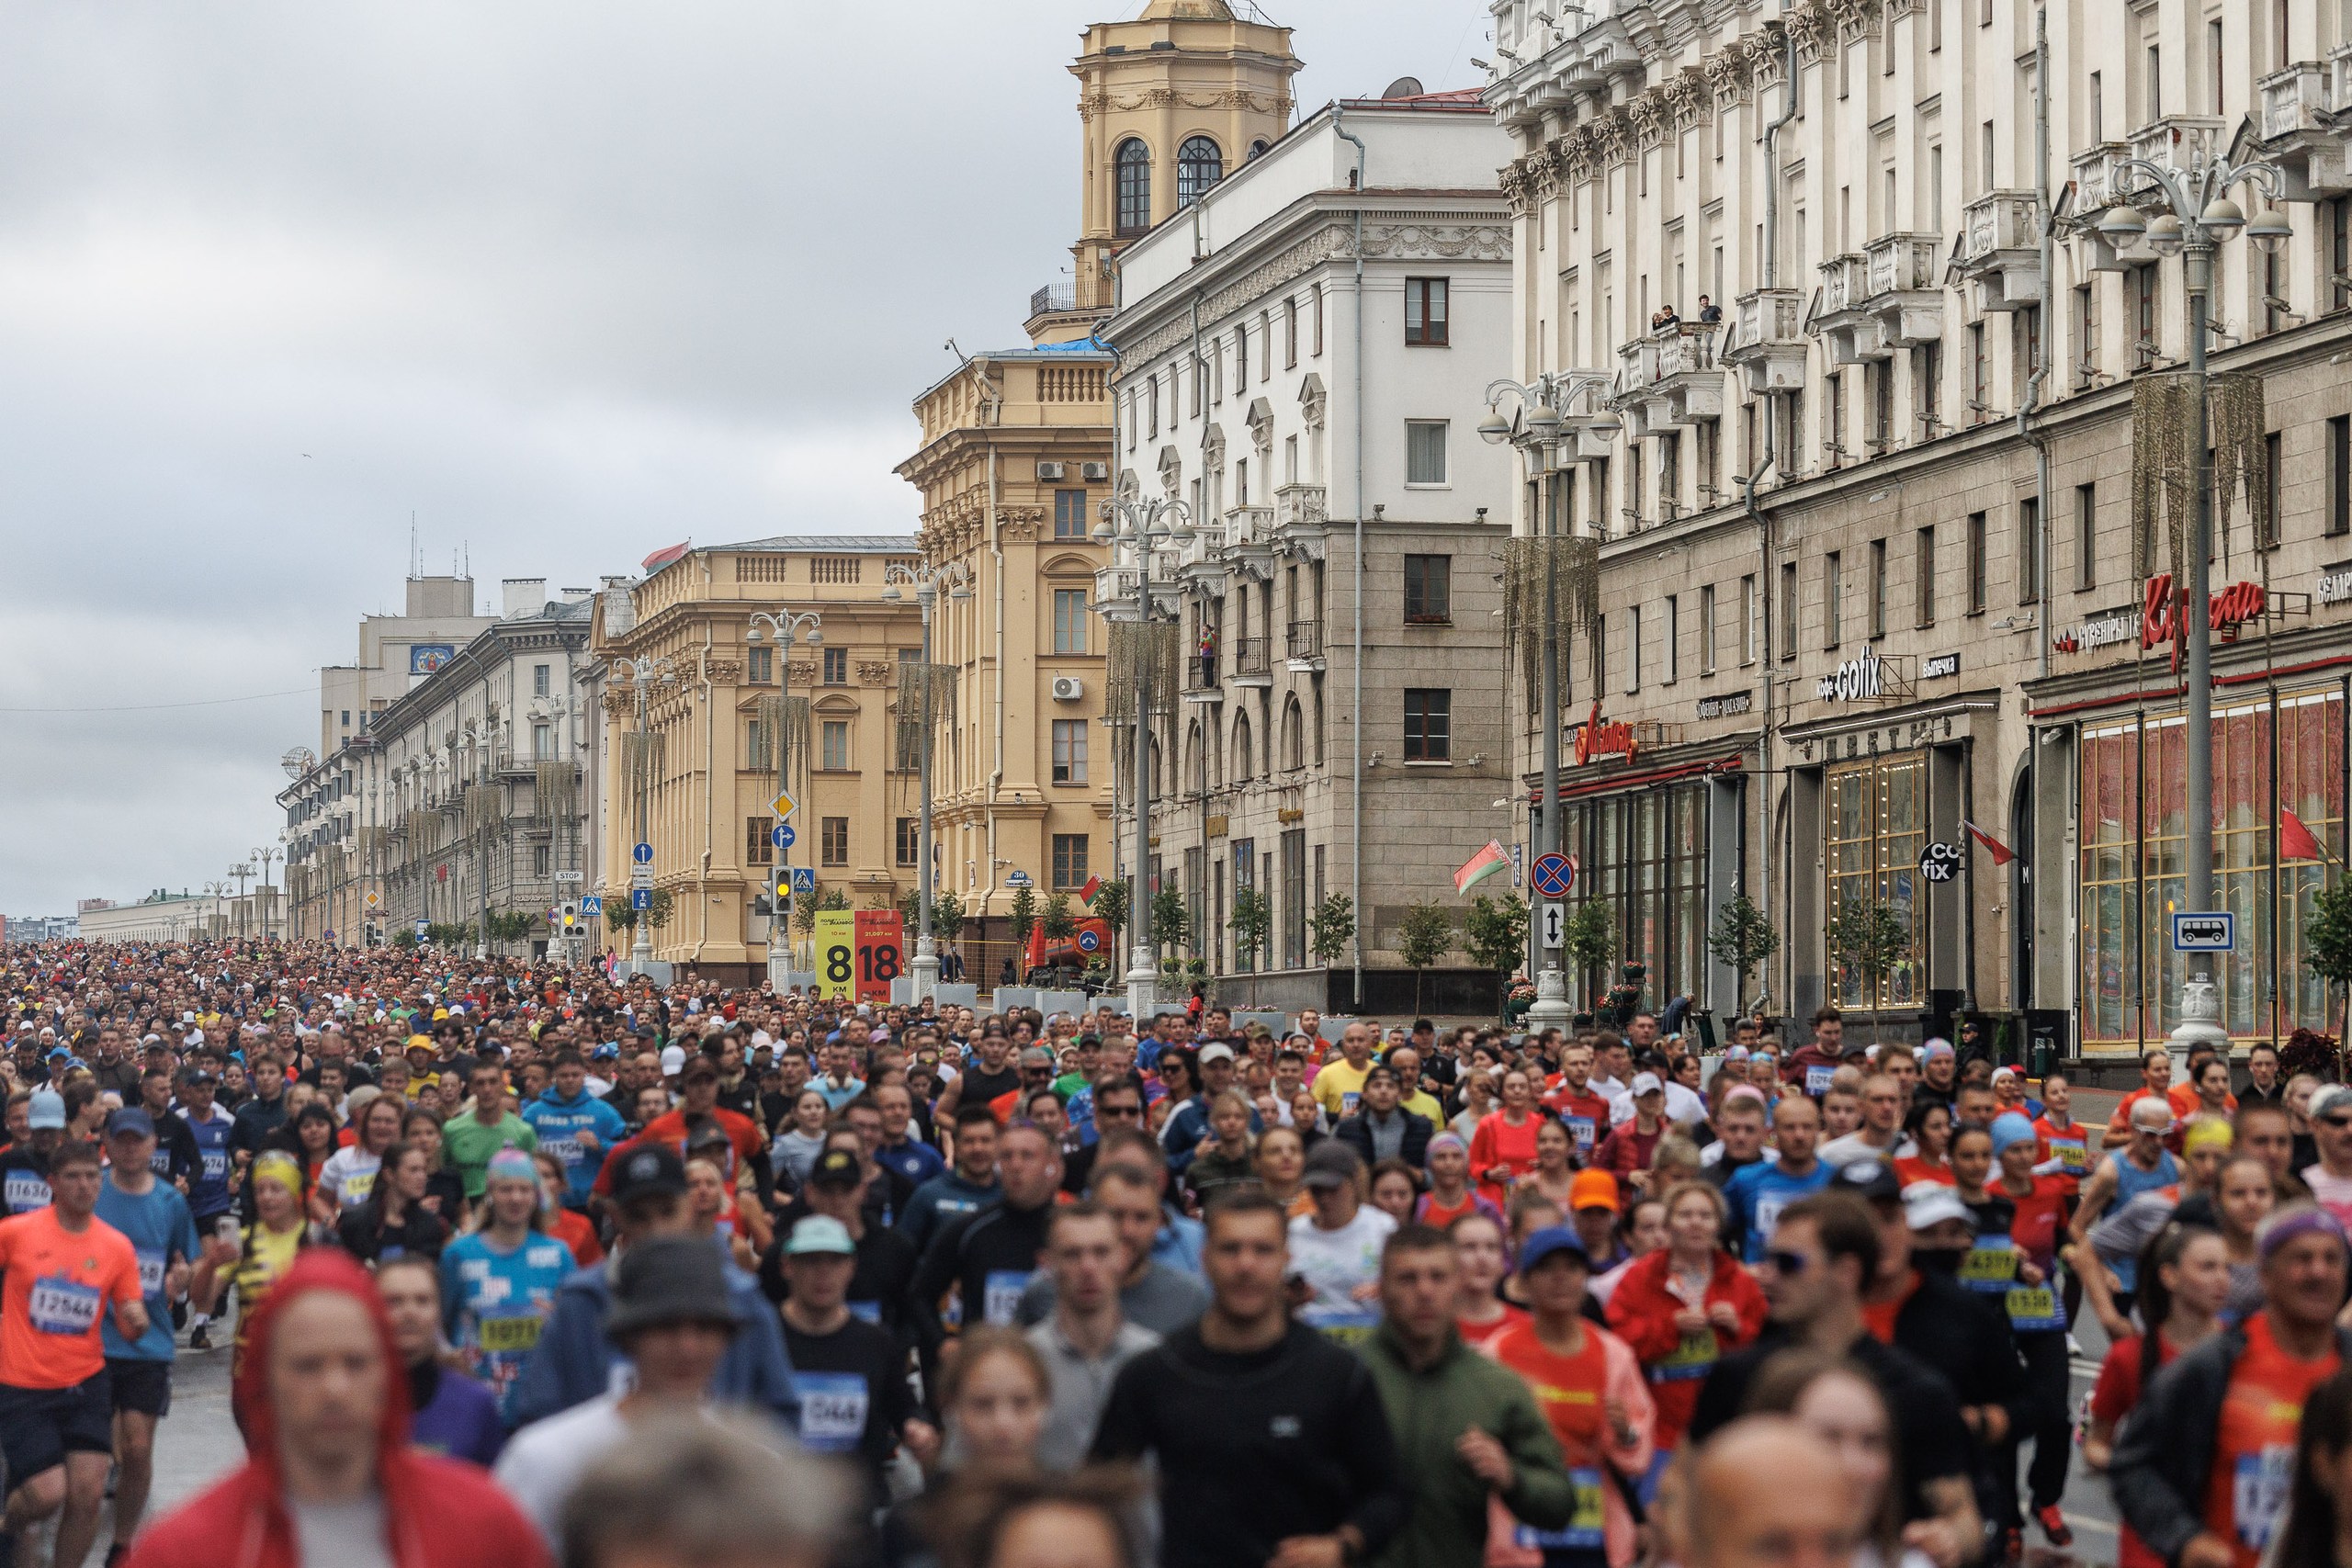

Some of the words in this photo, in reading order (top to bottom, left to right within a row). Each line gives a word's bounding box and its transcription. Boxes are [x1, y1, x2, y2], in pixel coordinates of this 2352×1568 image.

[1923, 657, 1954, 678] выпечка
[1922, 860, 1950, 879] fix
[827, 944, 852, 983] 8
[859, 944, 899, 982] 18
